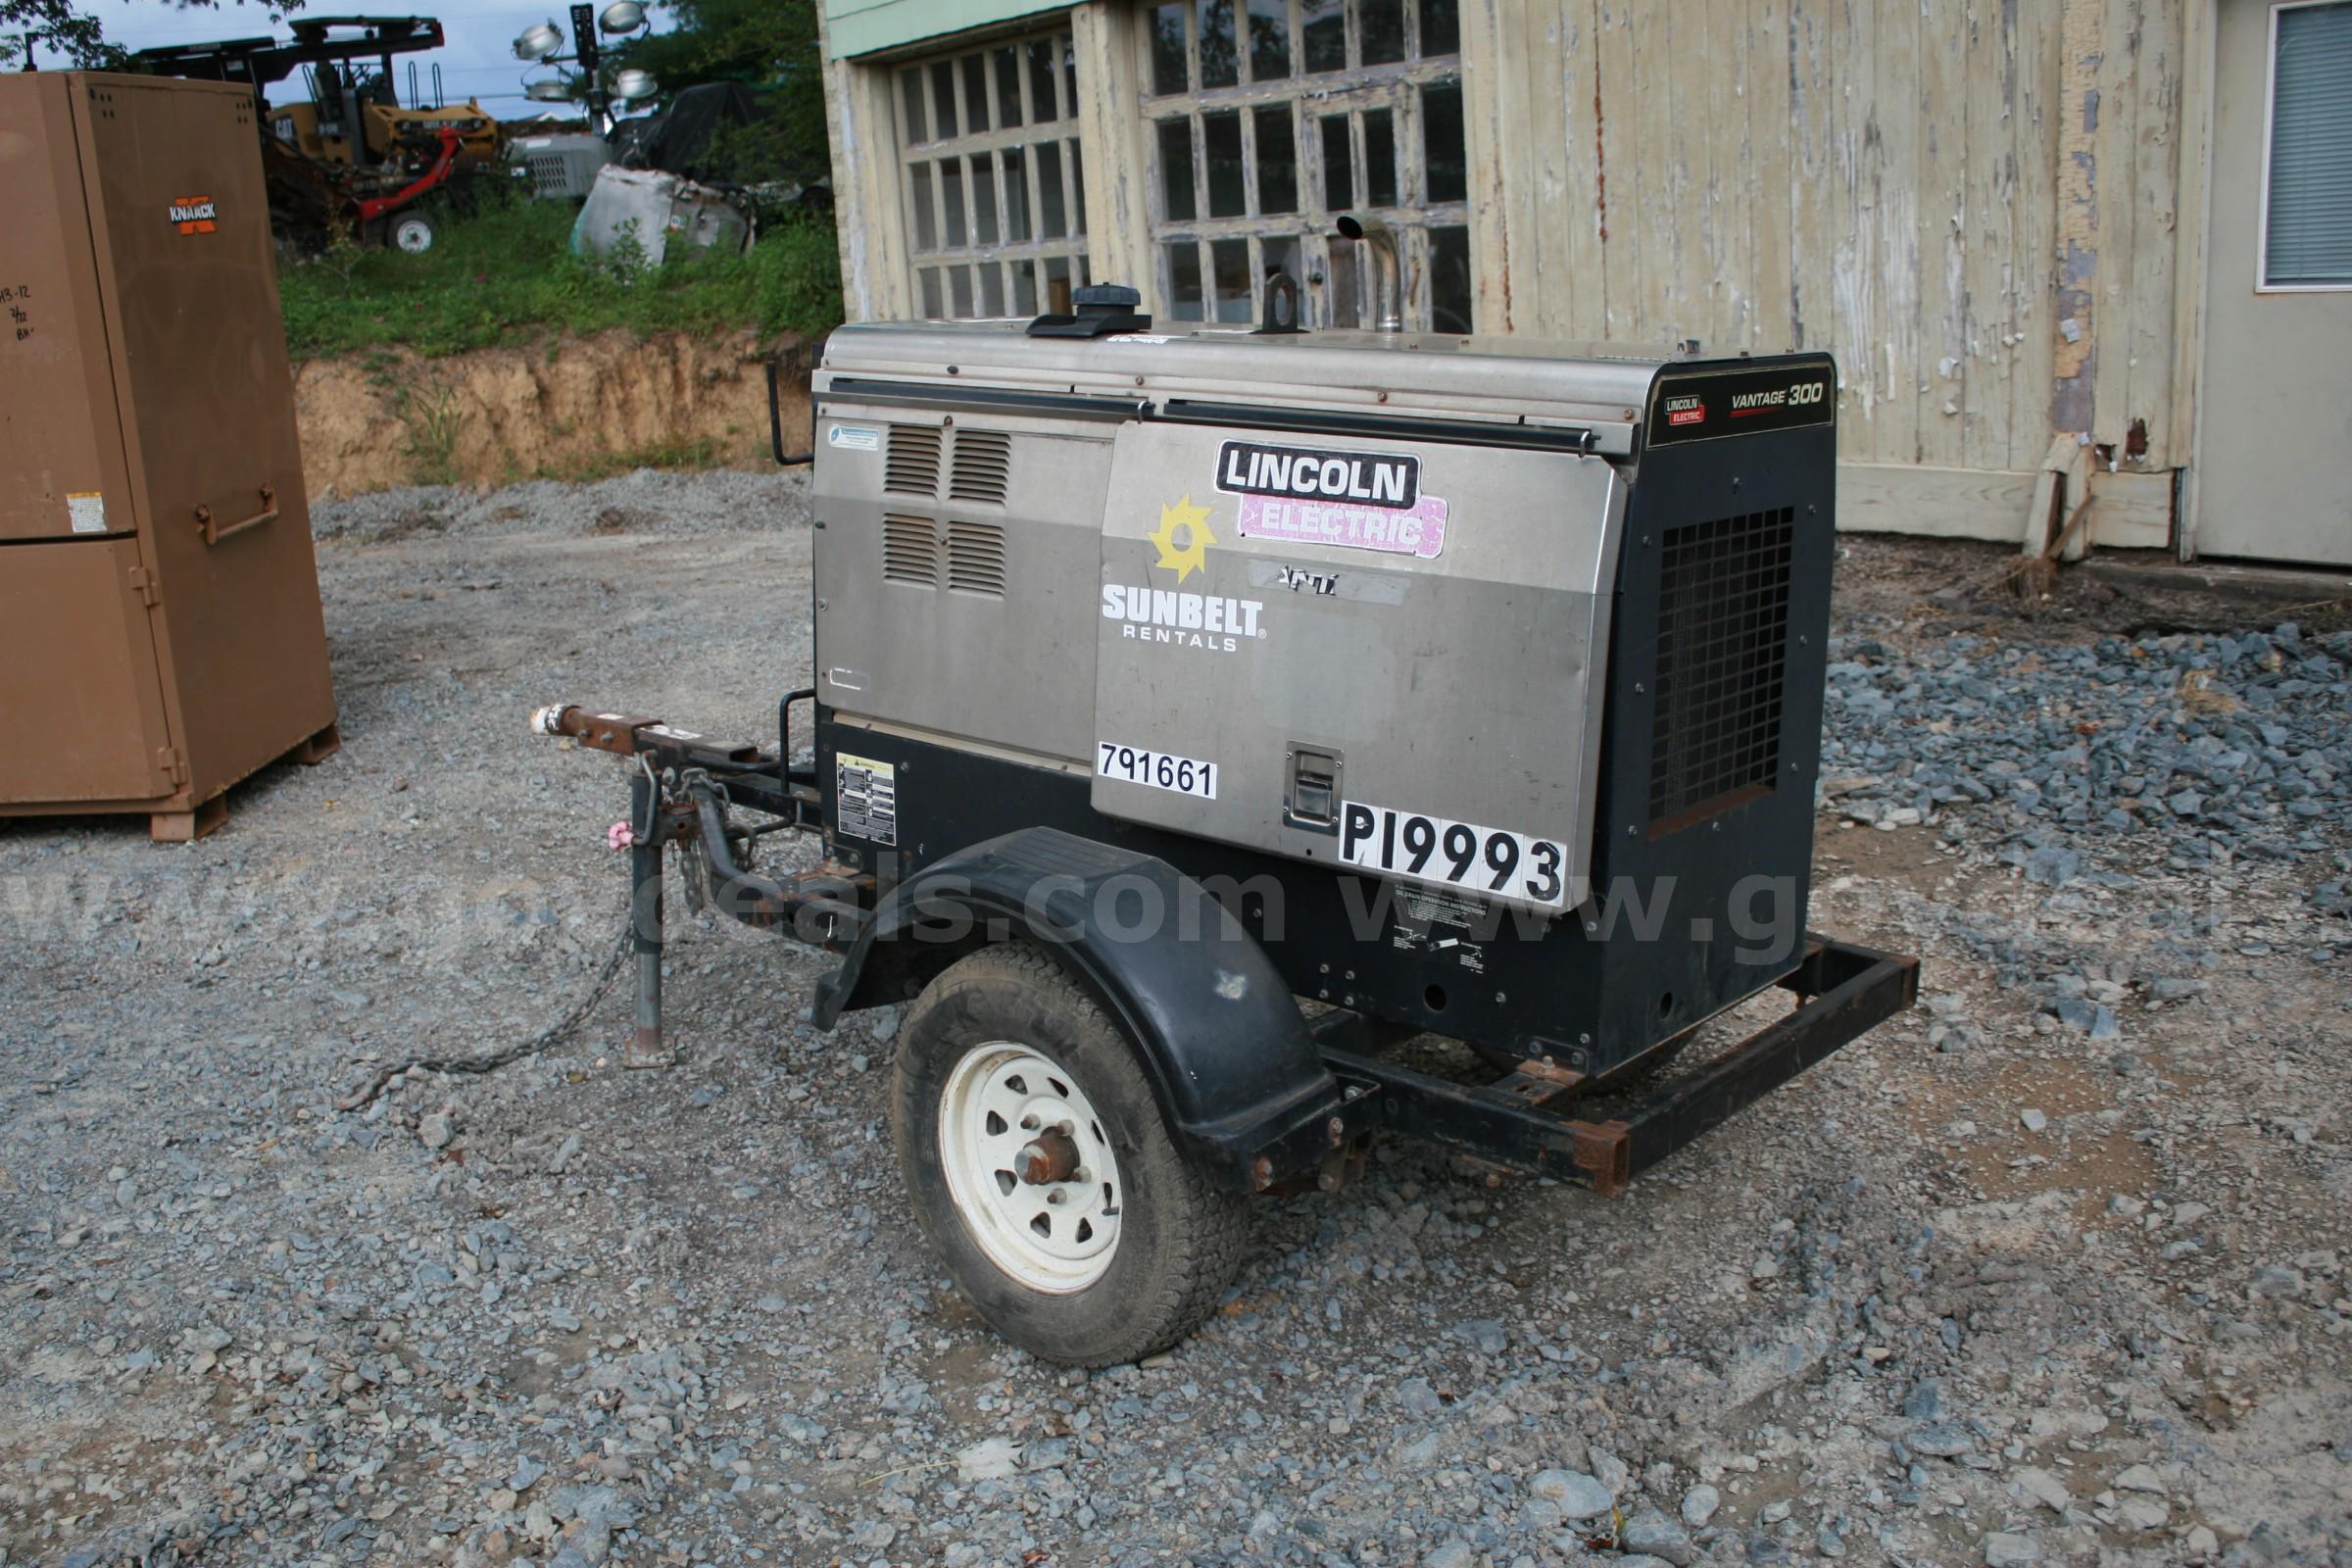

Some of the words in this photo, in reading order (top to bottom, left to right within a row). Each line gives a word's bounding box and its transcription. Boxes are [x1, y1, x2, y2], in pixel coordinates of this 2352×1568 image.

[170, 204, 216, 222] KNAACK
[1667, 398, 1697, 412] LINCOLN
[1732, 390, 1788, 409] VANTAGE
[1788, 382, 1823, 405] 300
[1673, 412, 1700, 422] ELECTRIC
[1226, 449, 1406, 502] LINCOLN
[1261, 502, 1423, 545] ELECTRIC
[1102, 583, 1263, 637] SUNBELT
[1122, 624, 1237, 652] RENTALS
[1101, 743, 1210, 796] 791661
